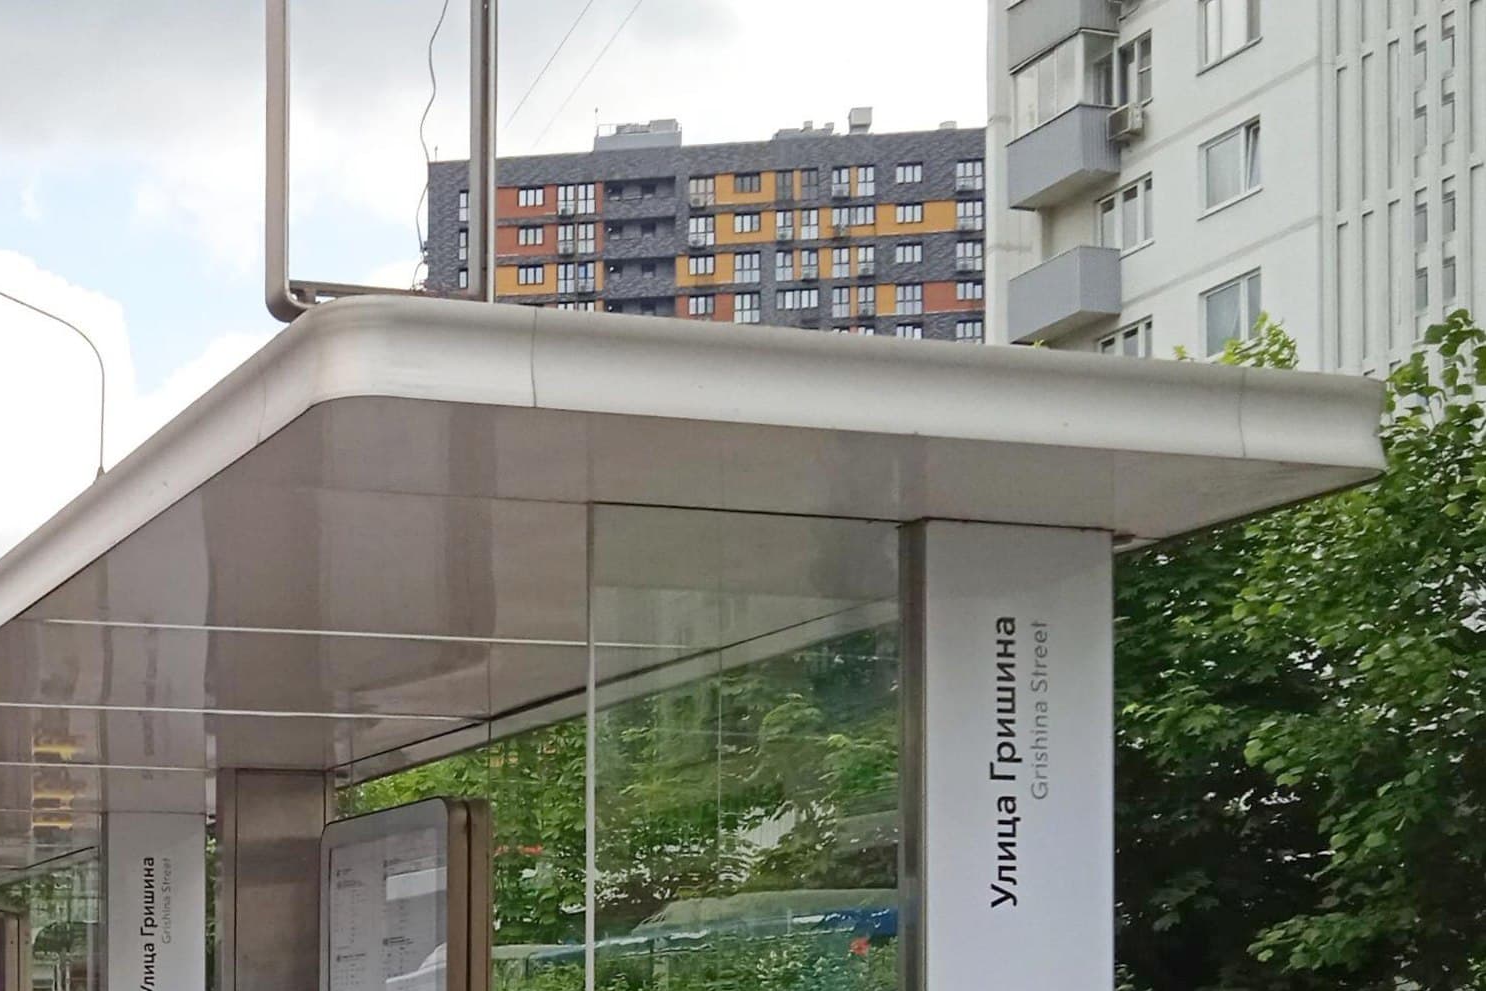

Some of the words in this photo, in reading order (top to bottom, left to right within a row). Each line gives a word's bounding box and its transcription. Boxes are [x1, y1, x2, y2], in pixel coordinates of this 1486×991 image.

[1030, 620, 1048, 693] Street
[990, 616, 1023, 781] Гришина
[1030, 701, 1048, 800] Grishina
[161, 857, 172, 892] Street
[990, 796, 1021, 907] Улица
[140, 856, 158, 937] Гришина
[161, 895, 172, 945] Grishina
